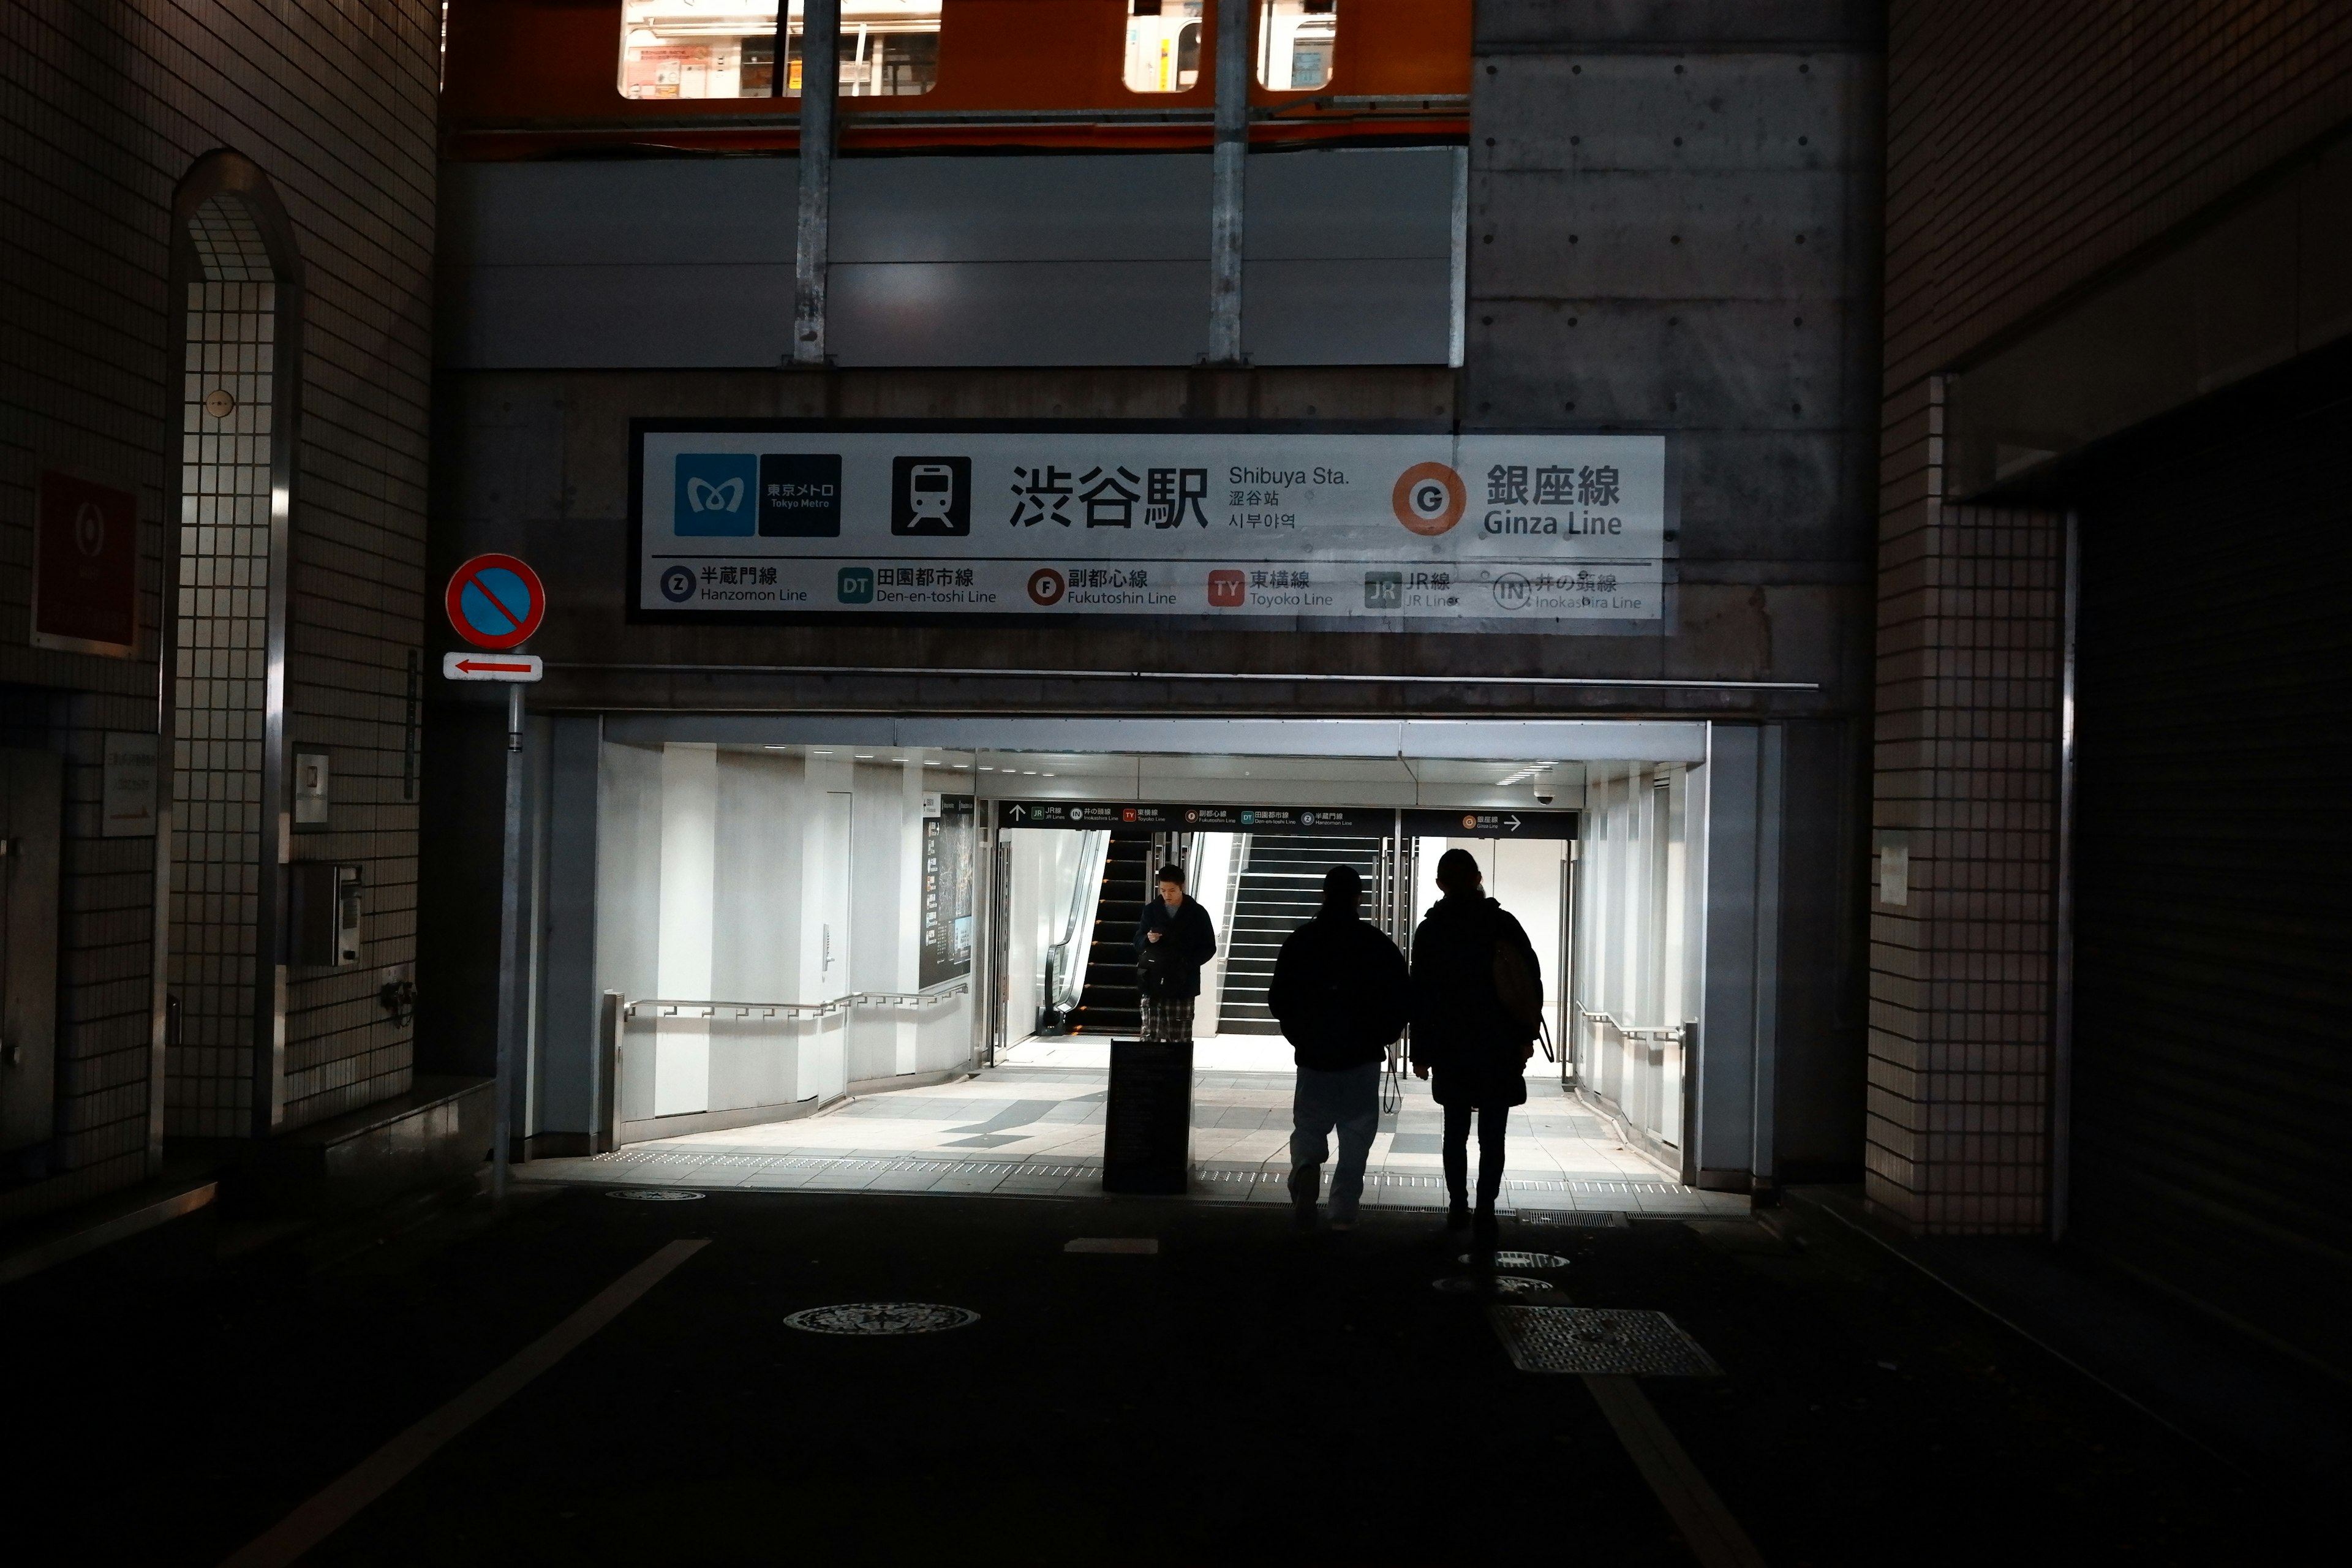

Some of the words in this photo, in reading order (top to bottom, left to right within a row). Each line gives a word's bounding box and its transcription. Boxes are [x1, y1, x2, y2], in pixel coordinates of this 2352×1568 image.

[1229, 467, 1306, 488] Shibuya
[1313, 467, 1349, 484] Sta.
[1487, 464, 1620, 507] 銀座線
[767, 484, 834, 497] 東京メトロ
[1010, 465, 1208, 529] 渋谷駅
[1229, 490, 1279, 507] 涩谷站
[772, 499, 798, 509] Tokyo
[801, 499, 829, 508] Metro
[1417, 486, 1442, 512] G
[1229, 513, 1295, 529] 시부야역
[1484, 510, 1557, 535] Ginza
[1569, 510, 1622, 535] Line
[673, 578, 684, 590] Z
[701, 567, 777, 585] 半蔵門線
[878, 568, 974, 587] 田園都市線
[1068, 569, 1148, 588] 副都心線
[1250, 570, 1310, 589] 東横線
[1406, 571, 1450, 590] JR線
[1536, 573, 1617, 592] 井の頭線
[843, 578, 869, 593] DT
[1042, 581, 1050, 594] F
[1215, 581, 1240, 596] TY
[1371, 581, 1395, 600] JR
[1500, 583, 1524, 599] IN
[701, 589, 775, 601] Hanzomon
[780, 589, 807, 601] Line
[877, 590, 964, 603] Den-en-toshi
[968, 590, 996, 603] Line
[1068, 591, 1144, 605] Fukutoshin
[1148, 592, 1177, 605] Line
[1251, 593, 1300, 608] Toyoko
[1305, 593, 1333, 606] Line
[1406, 595, 1423, 607] JR
[1536, 596, 1608, 609] Inokashira
[1613, 597, 1642, 609] Line
